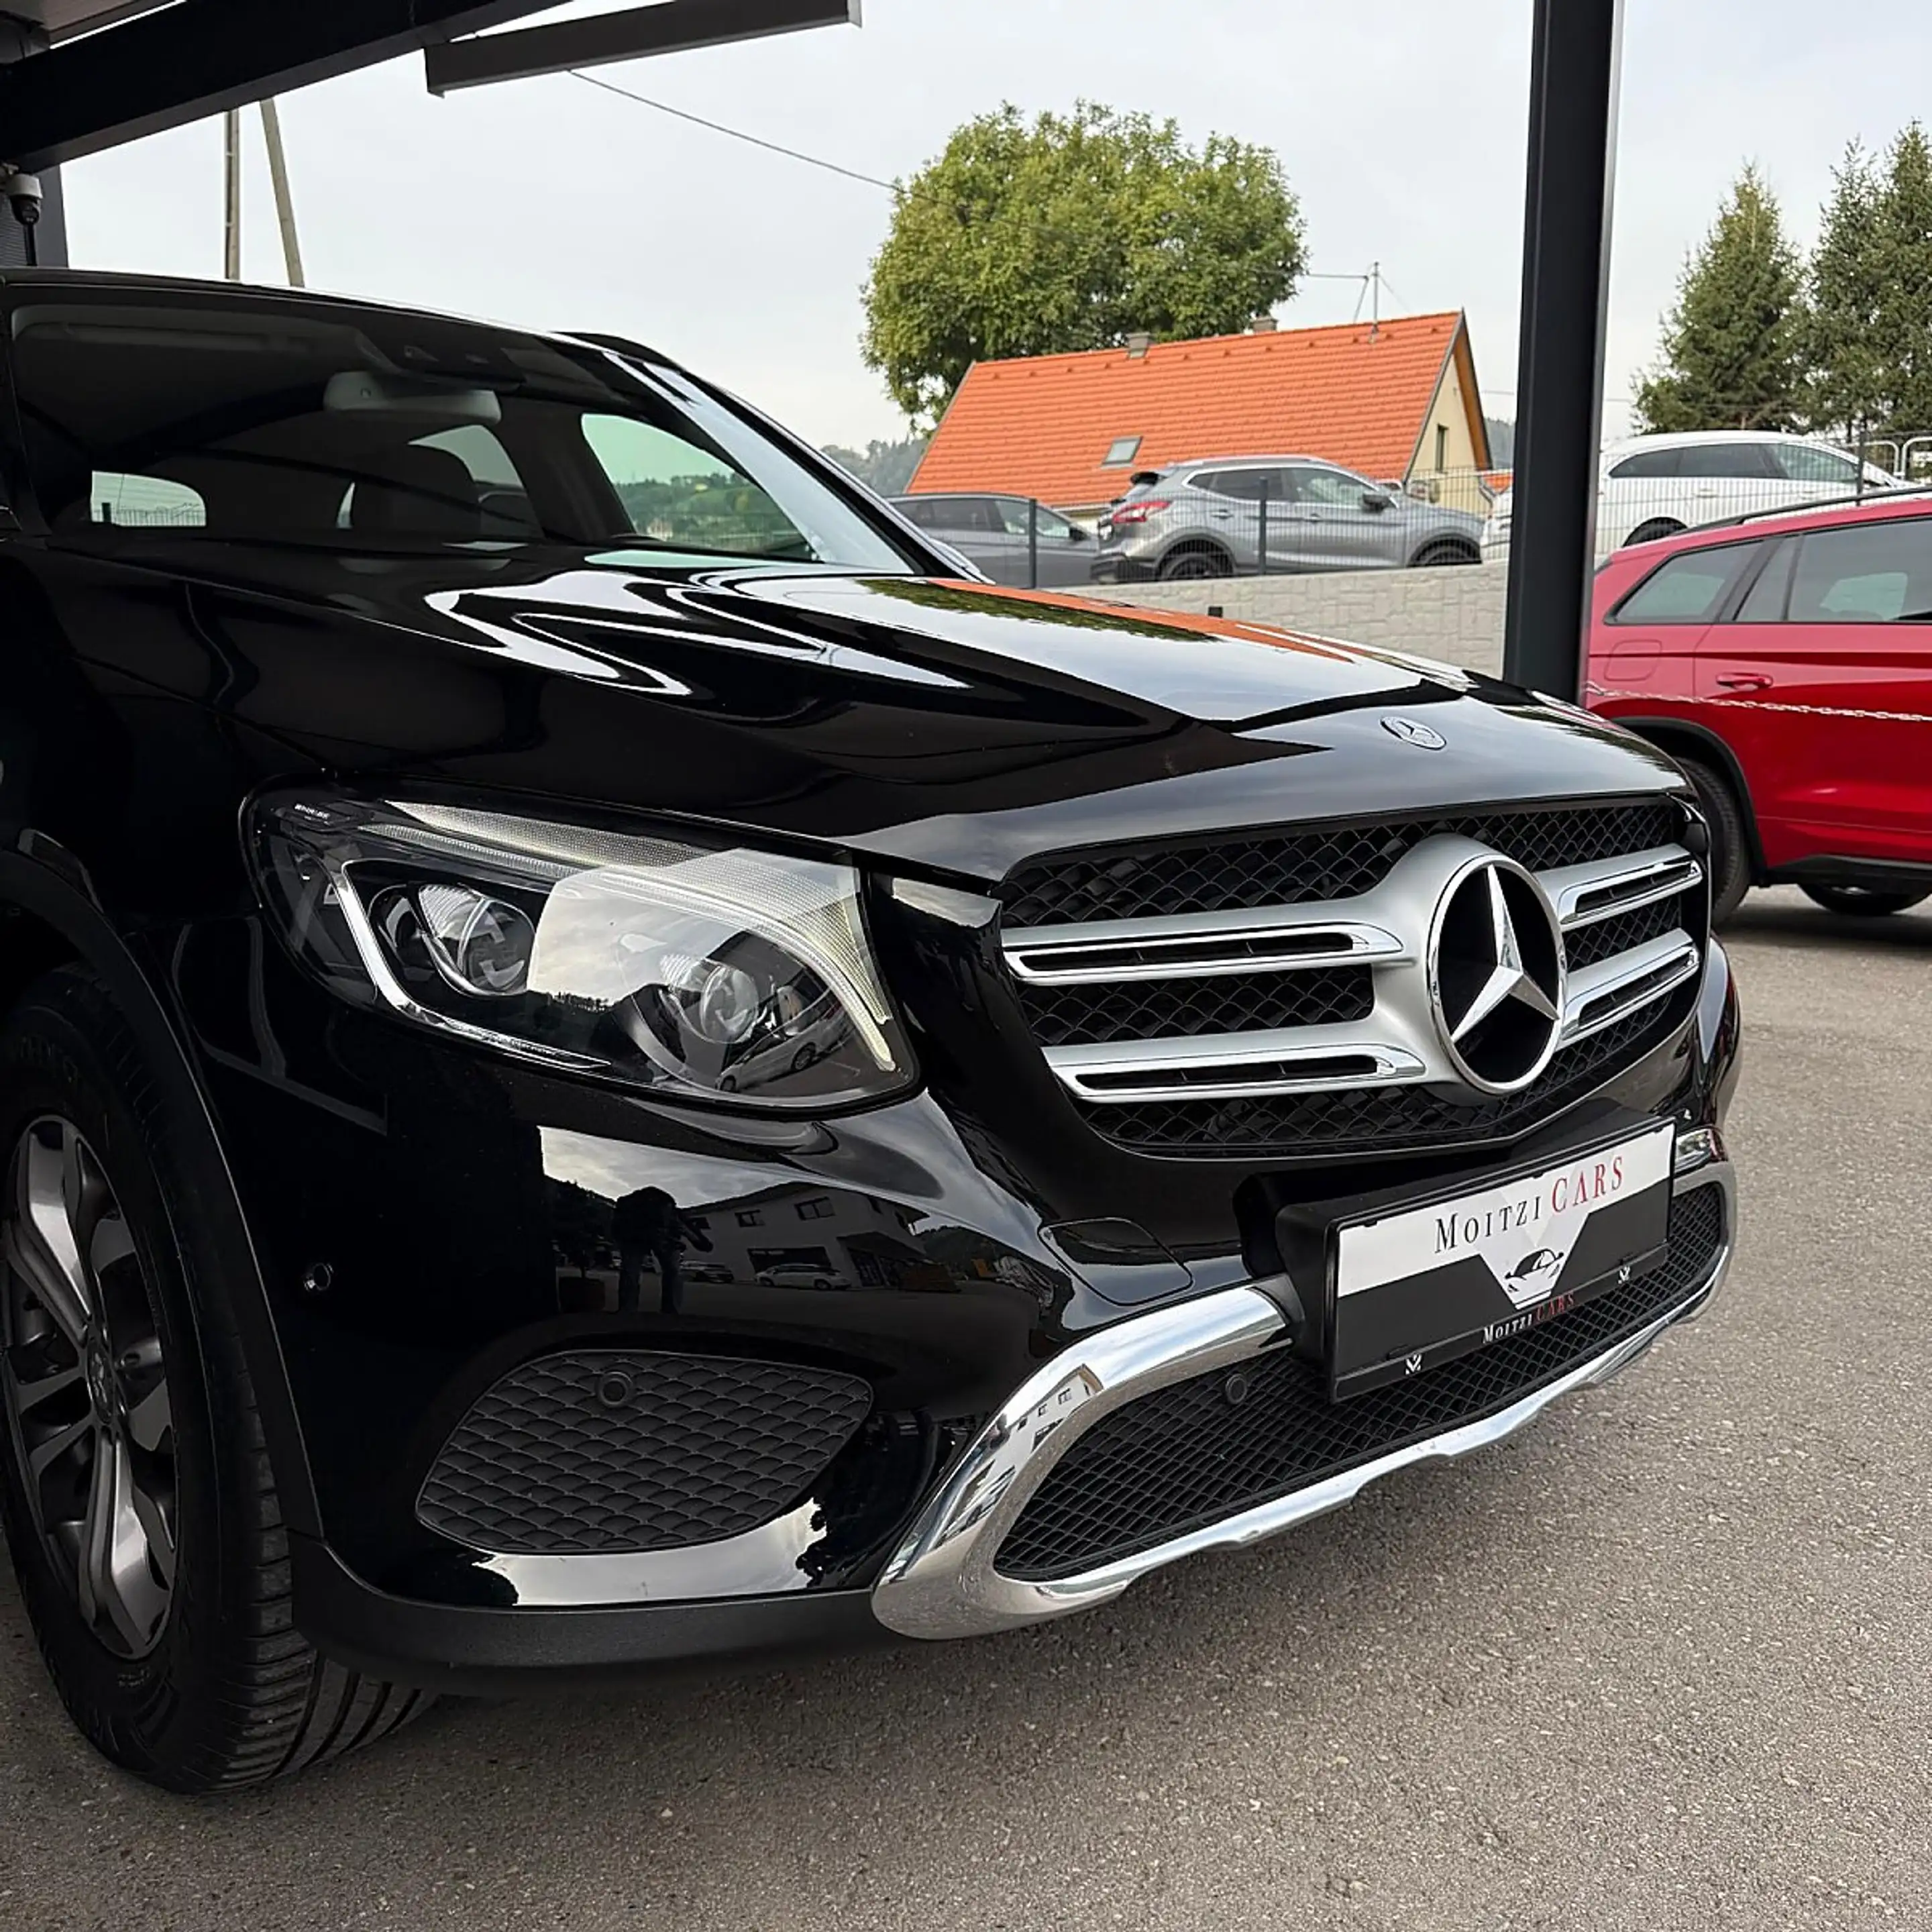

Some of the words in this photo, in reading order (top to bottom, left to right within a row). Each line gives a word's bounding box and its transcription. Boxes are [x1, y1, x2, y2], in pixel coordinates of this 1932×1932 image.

[1434, 1195, 1542, 1254] MOITZI
[1551, 1155, 1623, 1213] CARS
[1482, 1313, 1533, 1344] MOITZI
[1536, 1290, 1575, 1323] CARS
